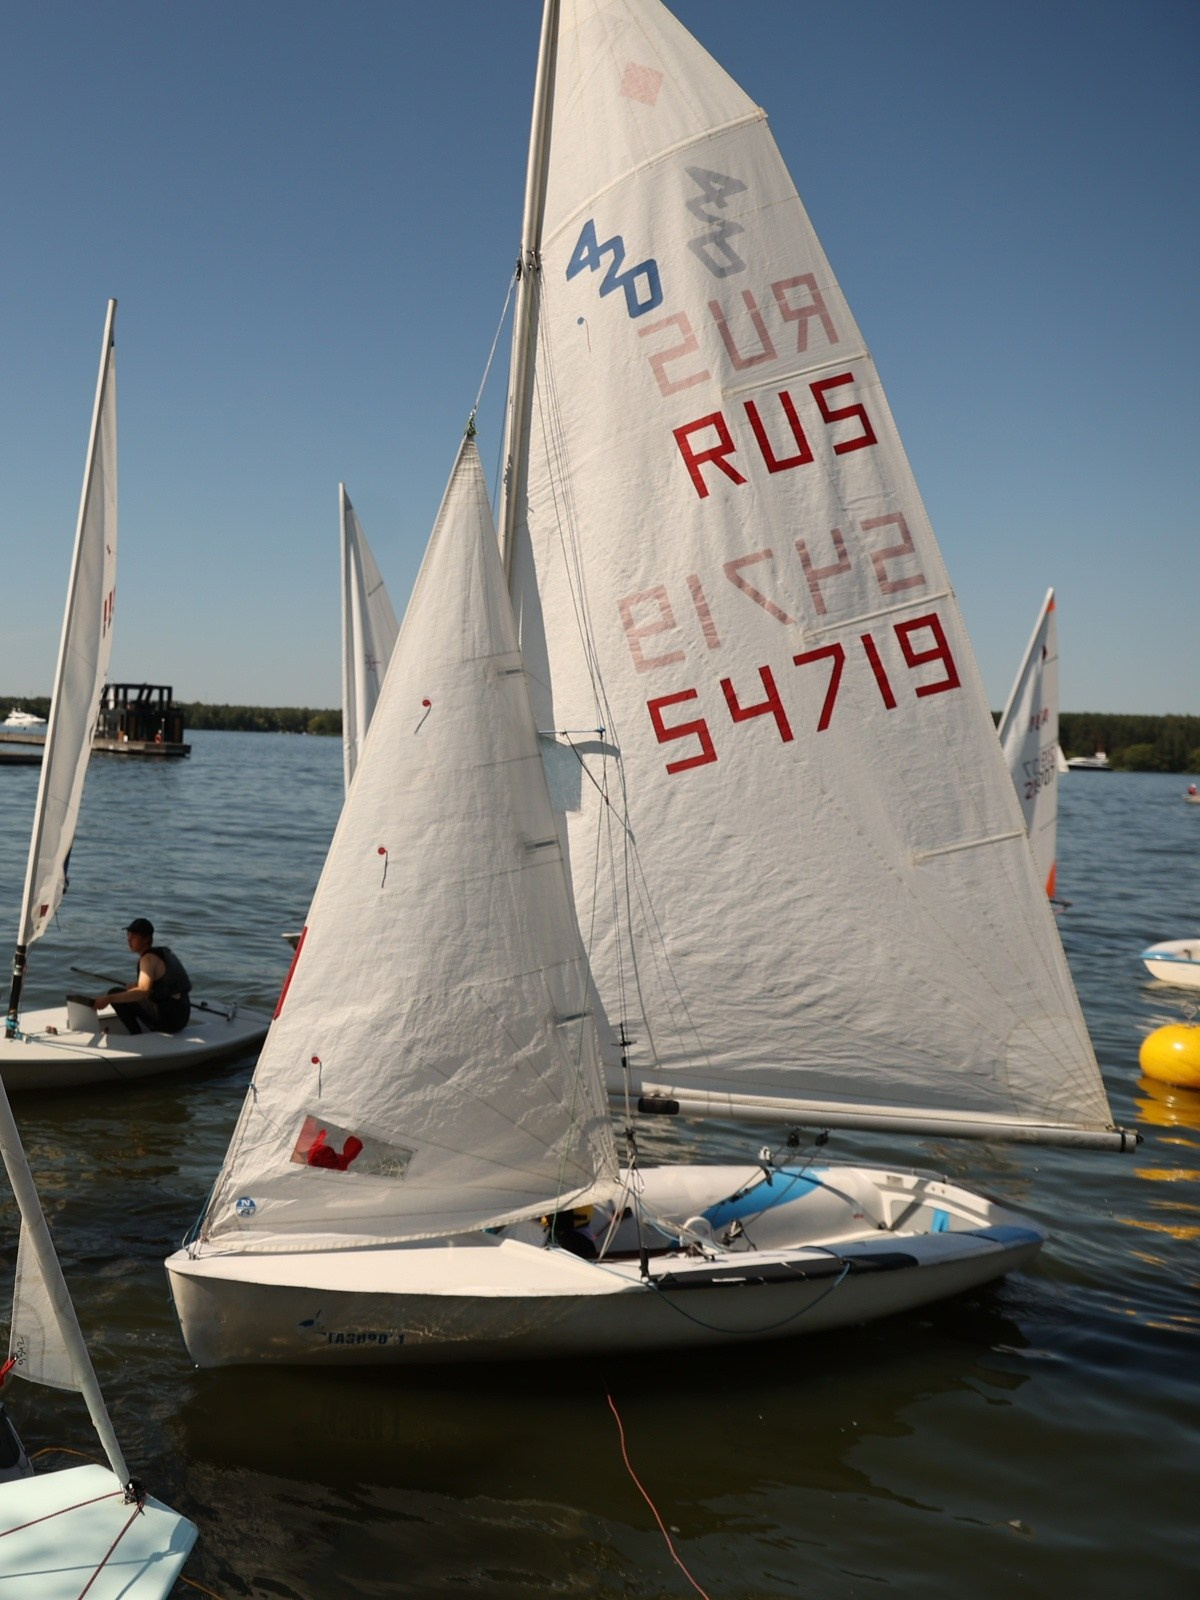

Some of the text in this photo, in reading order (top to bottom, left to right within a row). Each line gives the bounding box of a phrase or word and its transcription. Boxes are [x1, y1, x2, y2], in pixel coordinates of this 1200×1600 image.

[565, 218, 663, 318] 420
[672, 372, 878, 498] RUS
[646, 612, 962, 775] 54719
